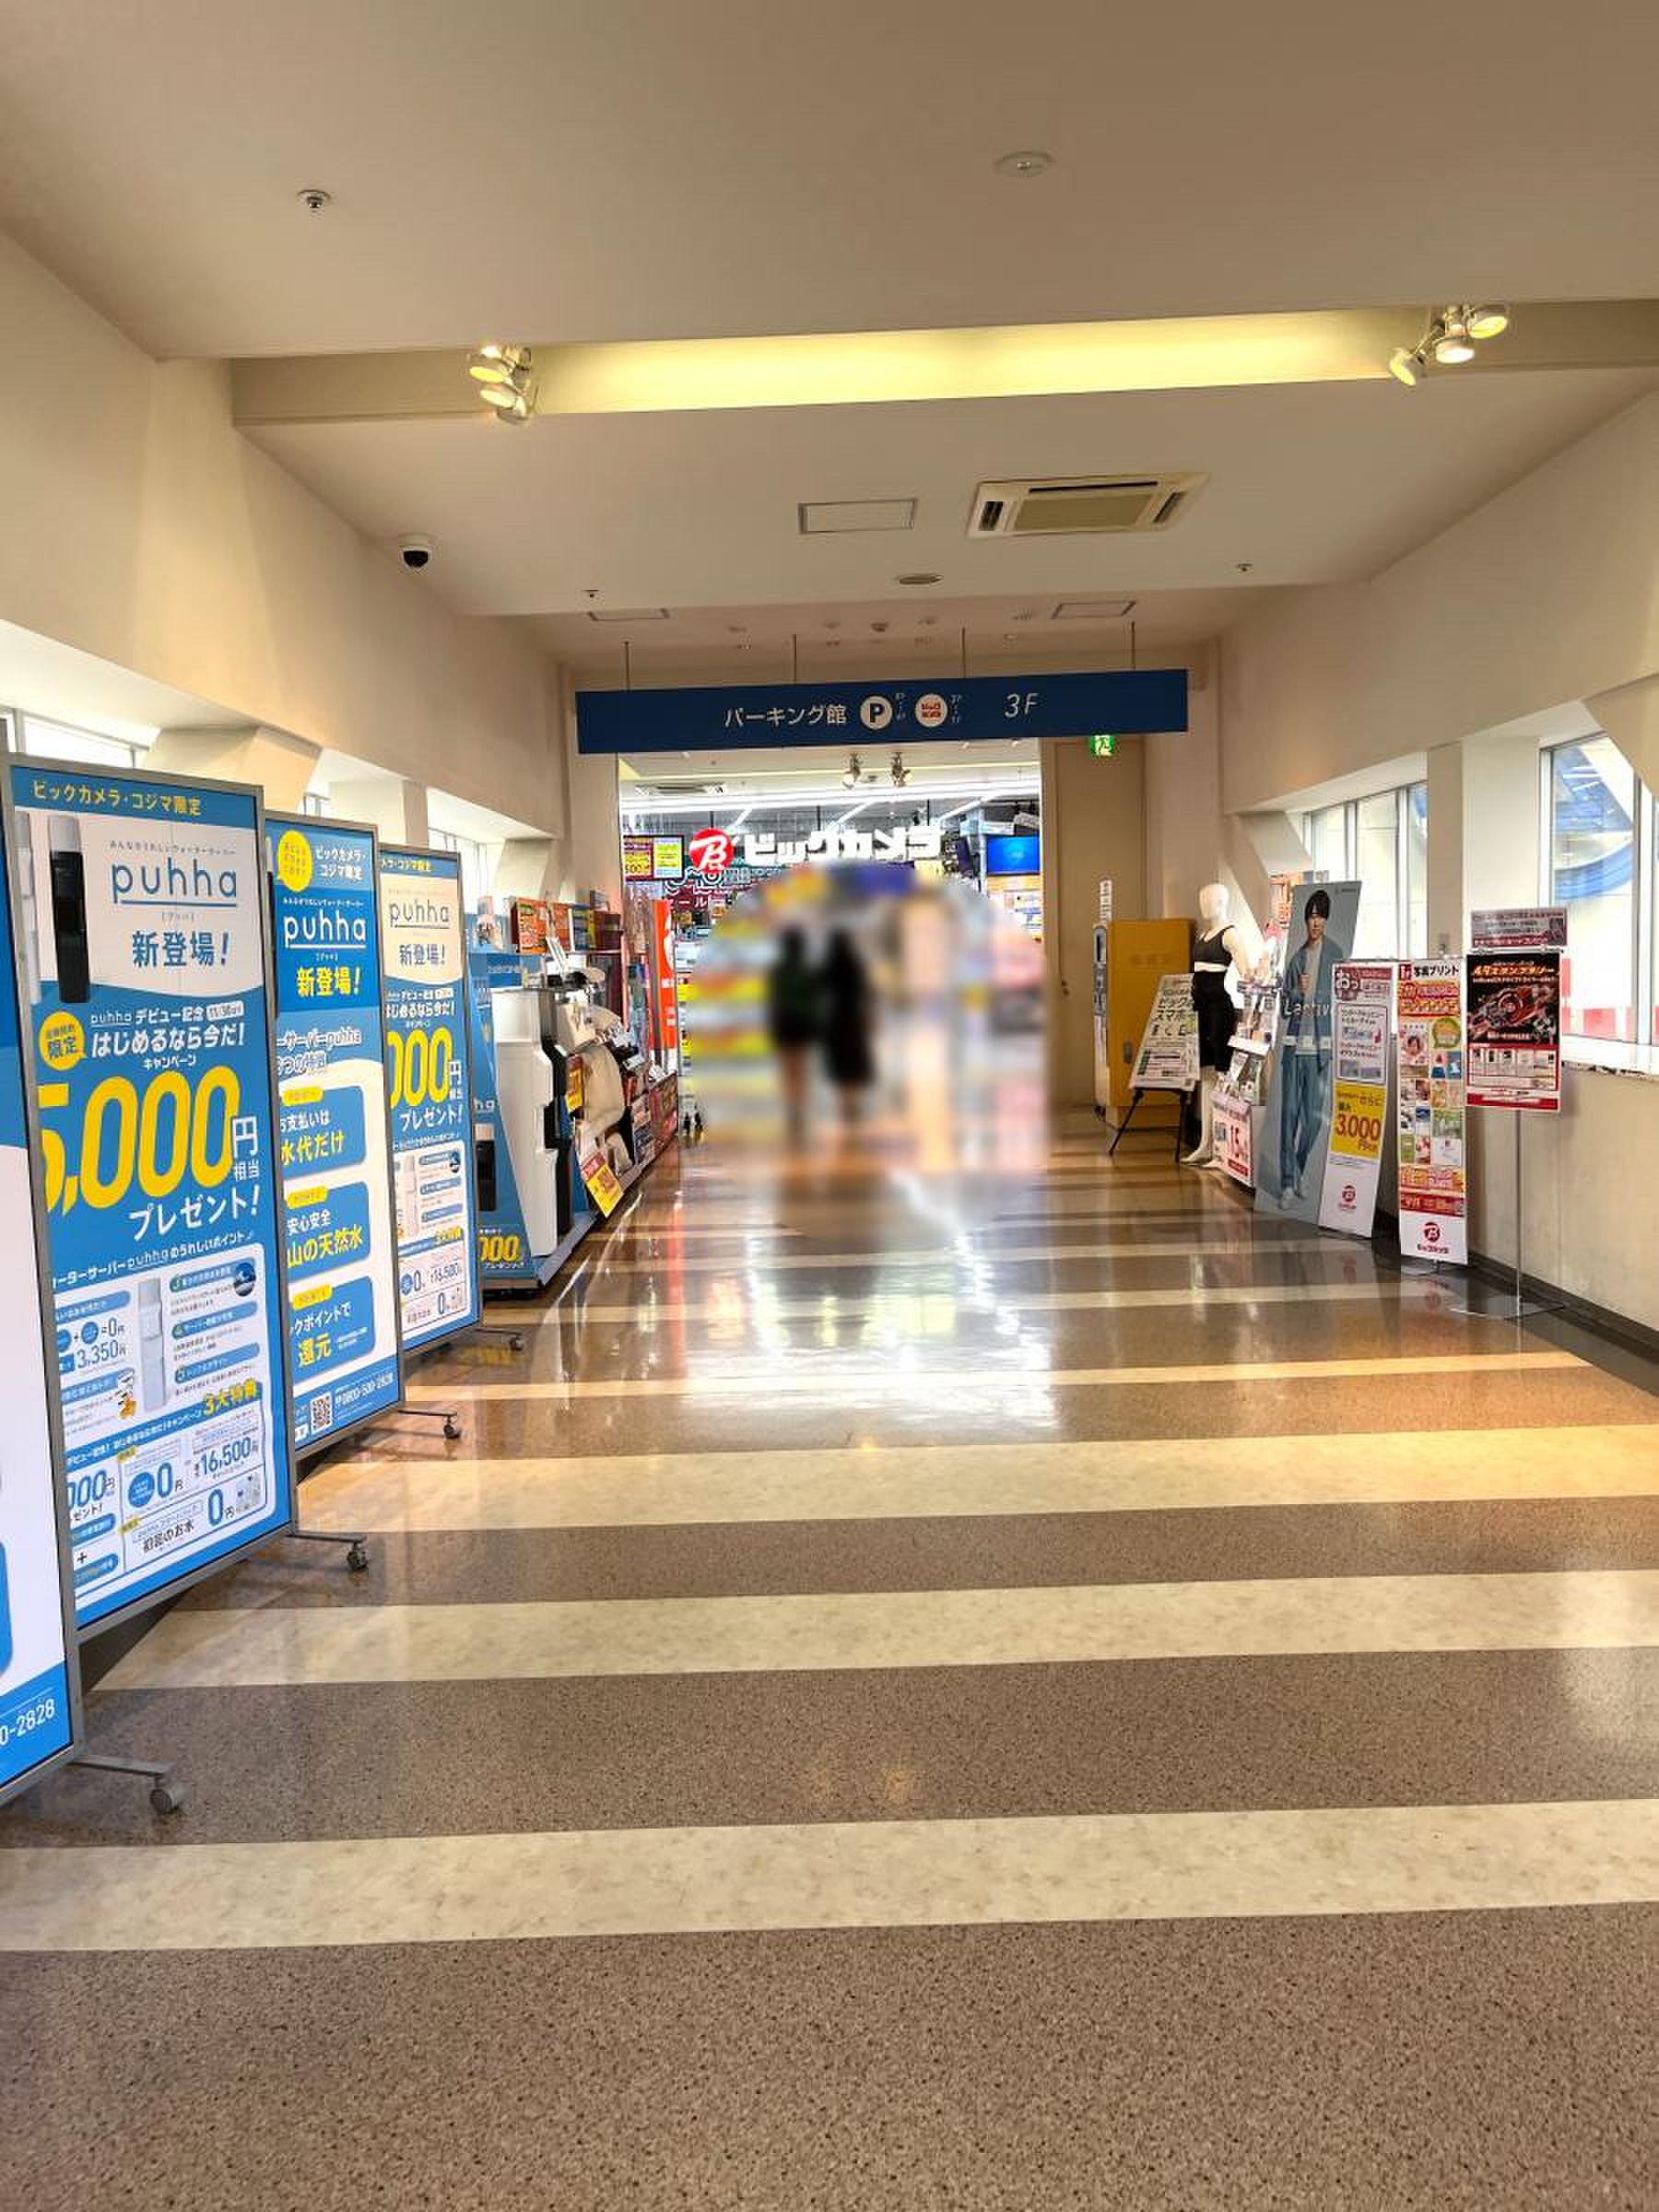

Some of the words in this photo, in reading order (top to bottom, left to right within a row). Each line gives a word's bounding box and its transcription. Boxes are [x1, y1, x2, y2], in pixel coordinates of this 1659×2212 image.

[724, 703, 848, 729] パーキング館
[1004, 693, 1039, 719] 3F
[744, 824, 942, 864] ビックカメラ
[111, 855, 237, 905] puhha
[284, 909, 366, 948] puhha
[389, 900, 451, 930] puhha
[92, 1022, 245, 1058] はじめるなら今だ!
[143, 1054, 197, 1070] キャンペーン
[231, 1114, 259, 1159] 円
[233, 1162, 261, 1182] 相当
[129, 1184, 261, 1241] プレゼント!
[289, 1301, 352, 1336] クポイントで
[298, 1333, 332, 1368] 還元
